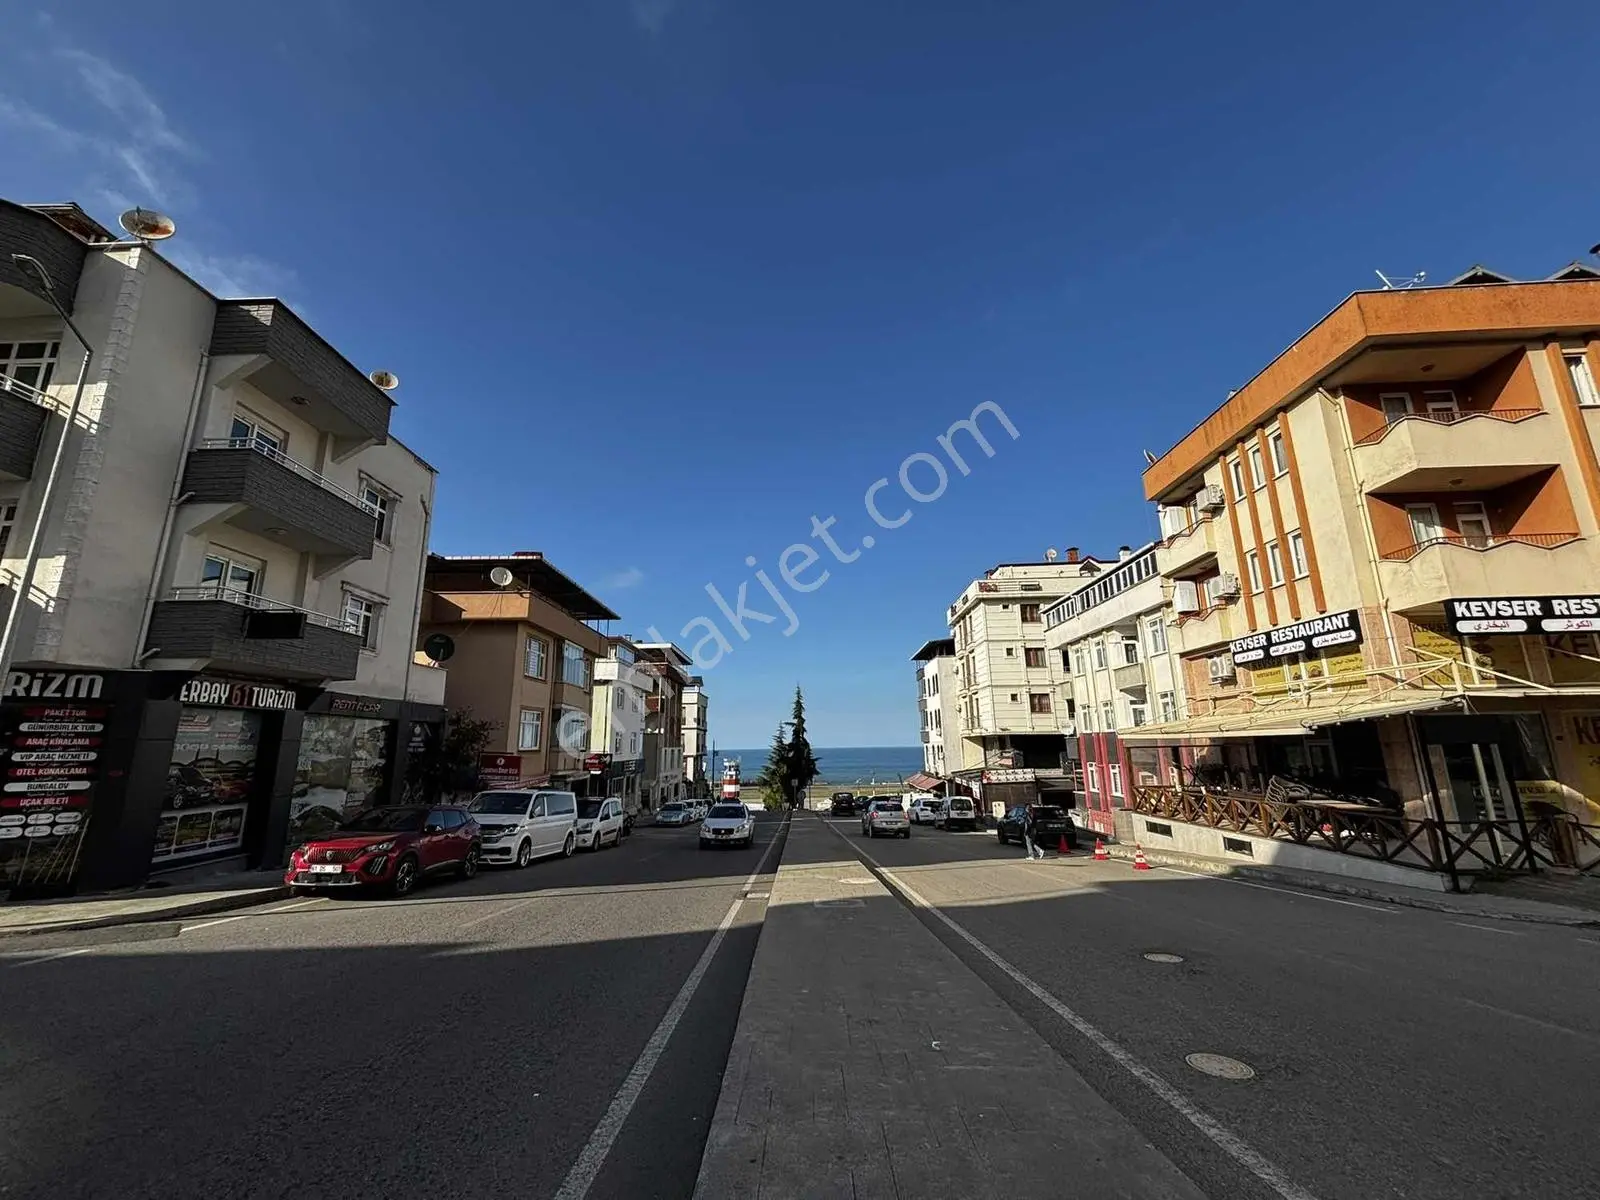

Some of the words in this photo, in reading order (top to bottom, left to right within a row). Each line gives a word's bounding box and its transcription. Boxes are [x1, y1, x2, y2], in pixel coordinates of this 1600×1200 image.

[1453, 600, 1543, 617] KEVSER
[1229, 634, 1268, 653] KEVSER
[1270, 613, 1351, 643] RESTAURANT
[180, 680, 231, 705] ERBAY
[232, 683, 249, 707] 61
[44, 709, 70, 717] PAKET
[16, 768, 36, 776] OTEL
[38, 767, 87, 775] KONAKLAMA
[27, 782, 70, 791] BUNGALOV
